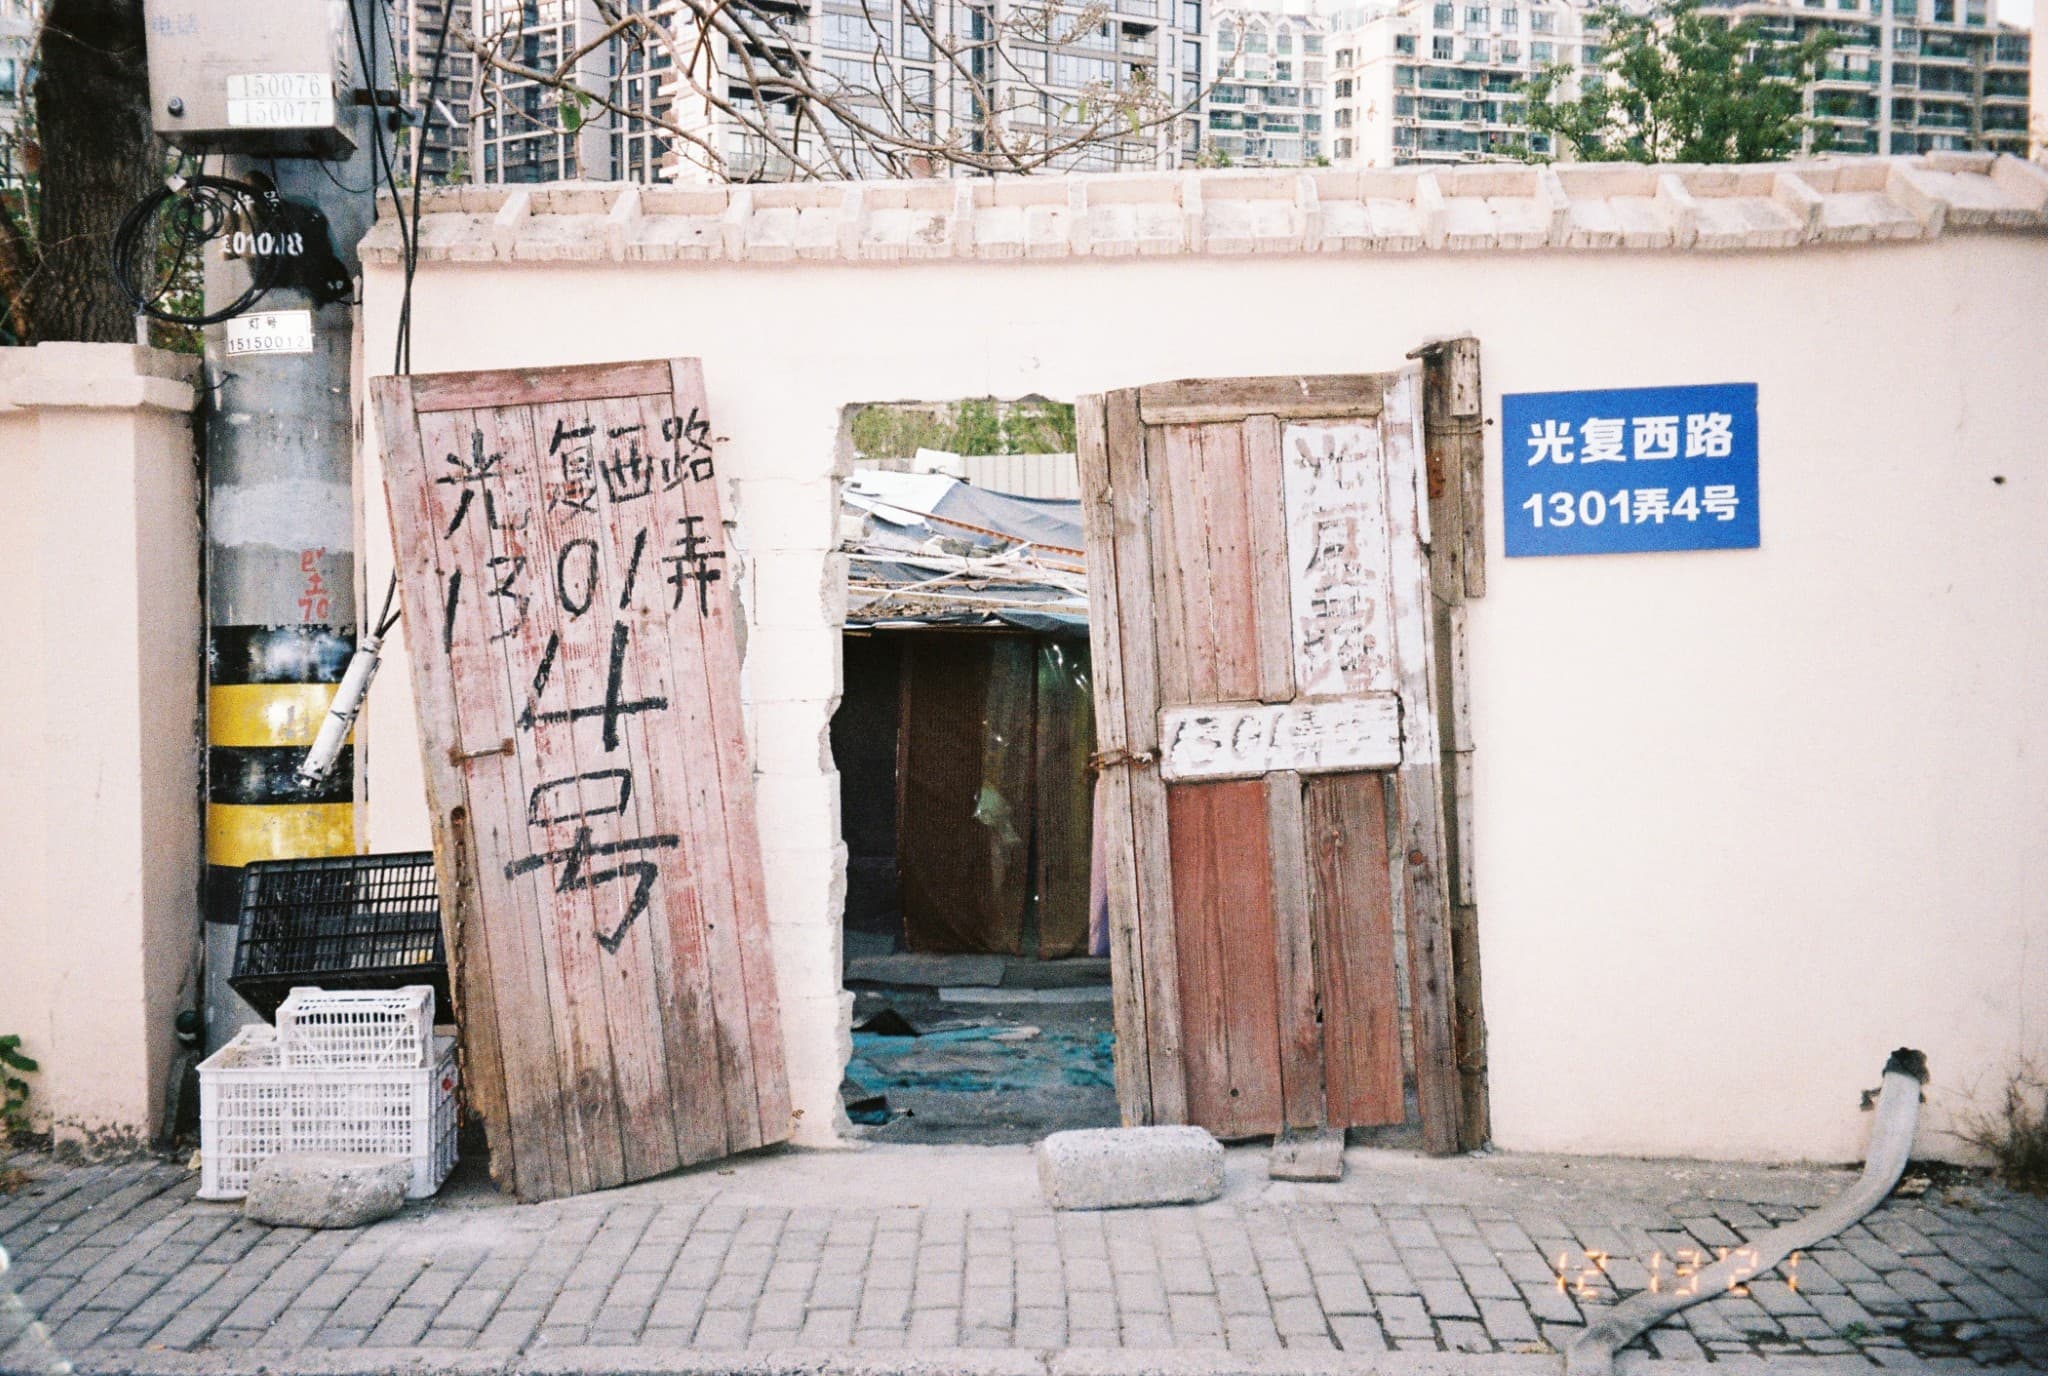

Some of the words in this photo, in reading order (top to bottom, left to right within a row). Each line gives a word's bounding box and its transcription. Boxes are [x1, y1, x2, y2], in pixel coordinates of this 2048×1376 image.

[243, 75, 321, 97] 150076
[243, 101, 322, 124] 150077
[229, 335, 306, 351] 15150012
[1527, 411, 1734, 467] 光复西路
[436, 406, 716, 540] 光复西路
[1522, 484, 1740, 529] 1301弄4号
[439, 515, 727, 655] 1301弄
